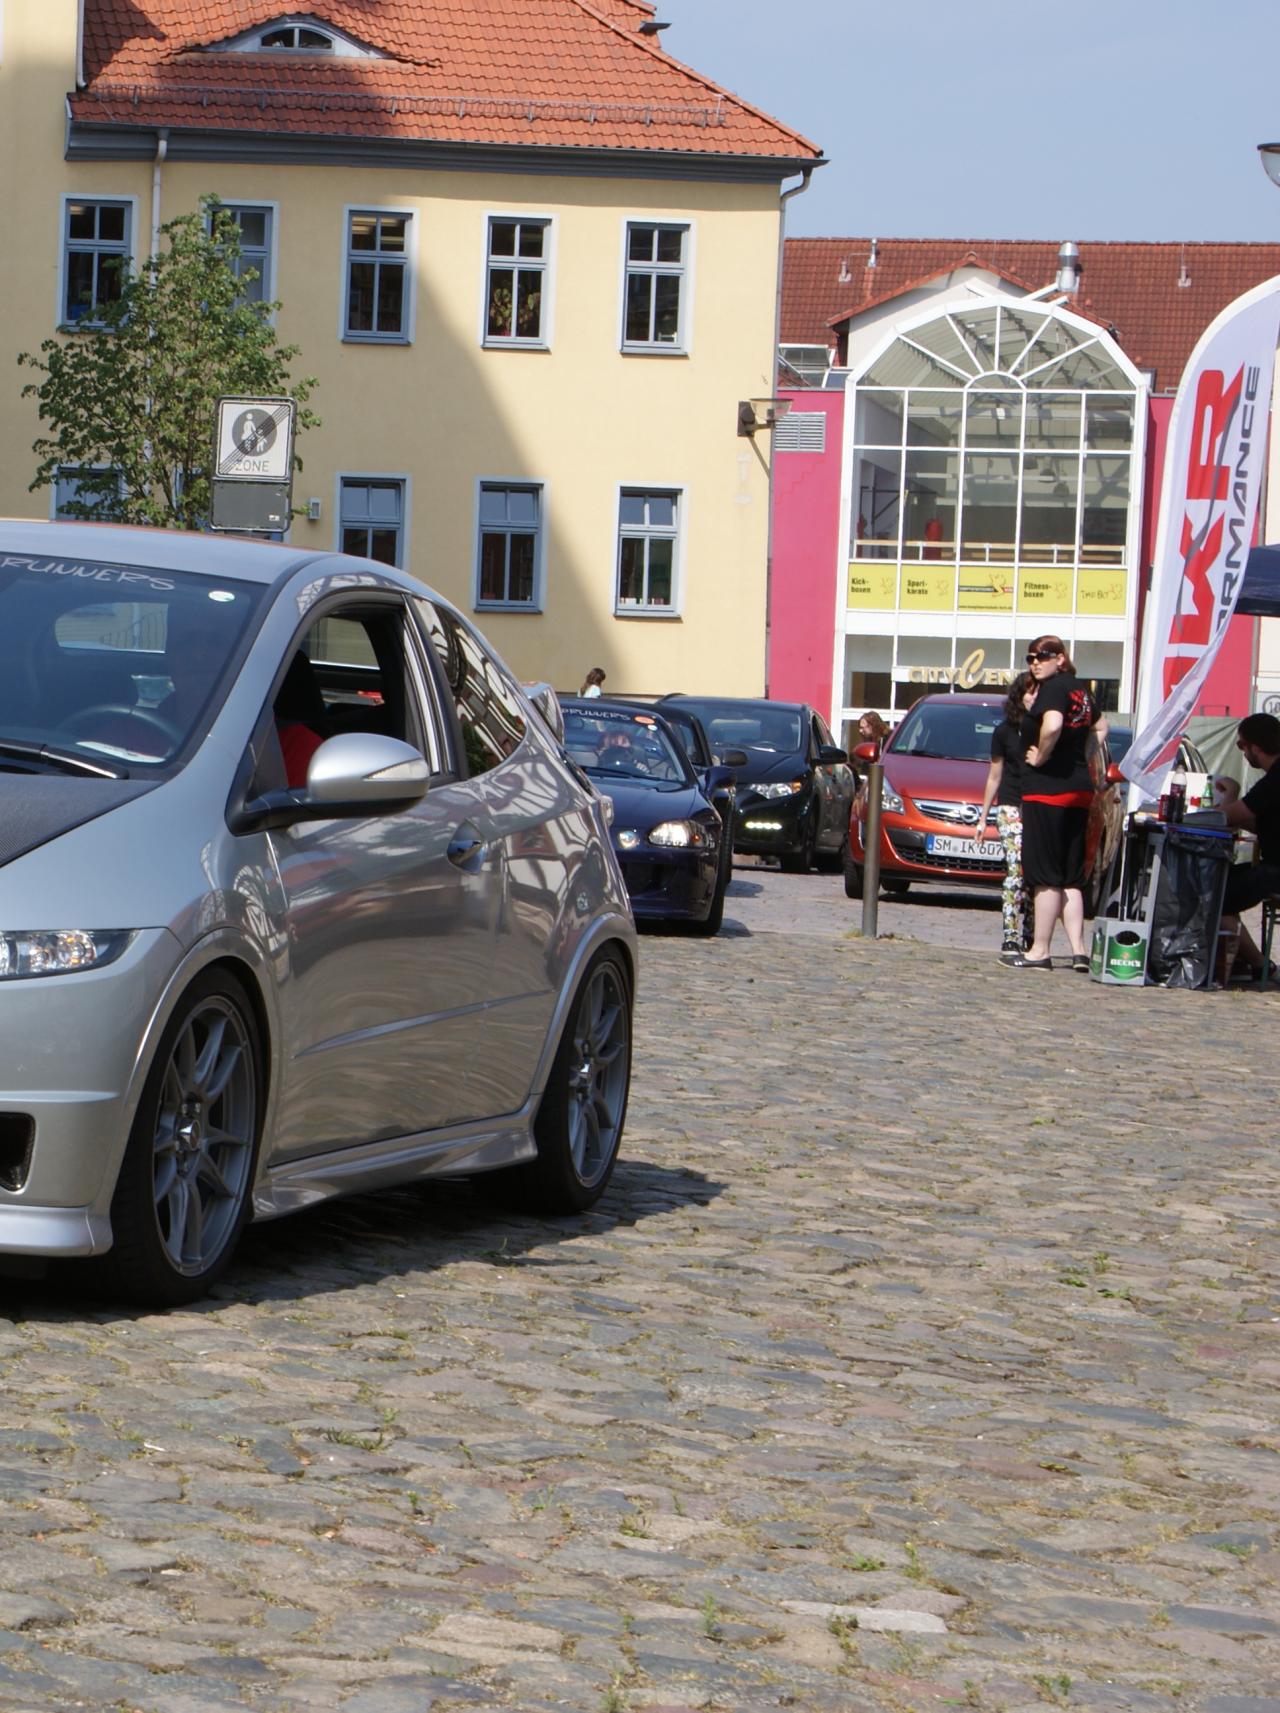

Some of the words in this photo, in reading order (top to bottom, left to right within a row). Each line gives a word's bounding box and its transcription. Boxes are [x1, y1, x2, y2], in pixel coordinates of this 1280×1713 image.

[235, 459, 270, 472] ZONE
[1163, 362, 1245, 704] KR
[908, 667, 959, 683] CITY
[935, 838, 952, 852] SM
